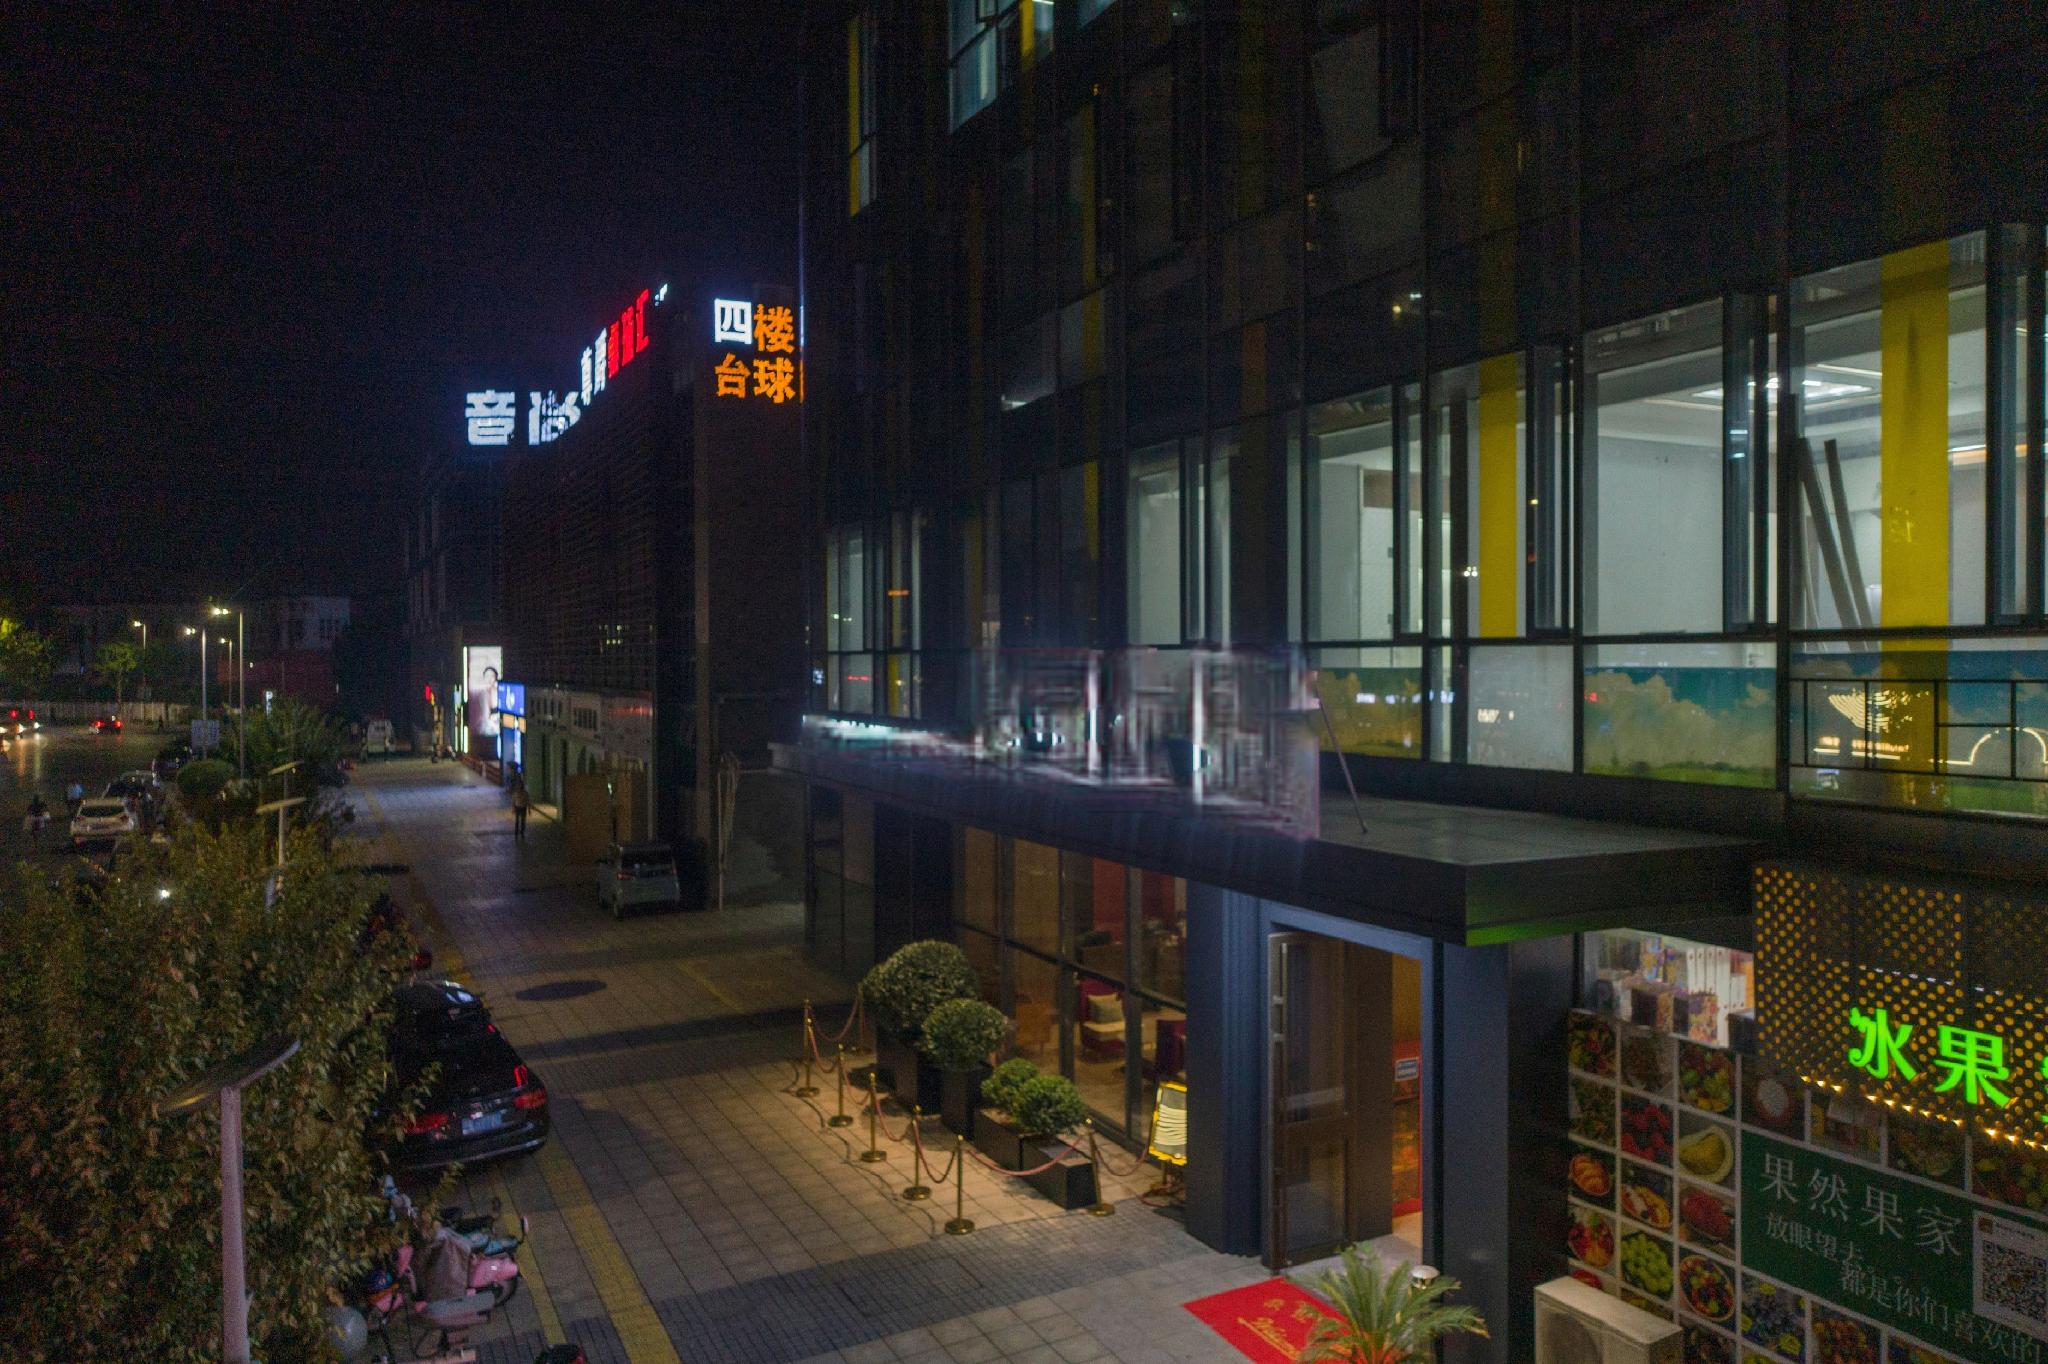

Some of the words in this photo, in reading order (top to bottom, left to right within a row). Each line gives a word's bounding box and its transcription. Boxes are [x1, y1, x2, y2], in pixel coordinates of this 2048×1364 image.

[714, 298, 796, 353] 四楼
[714, 352, 796, 405] 台球
[1848, 1006, 2048, 1122] 水果
[1760, 1153, 1962, 1256] 果然果家
